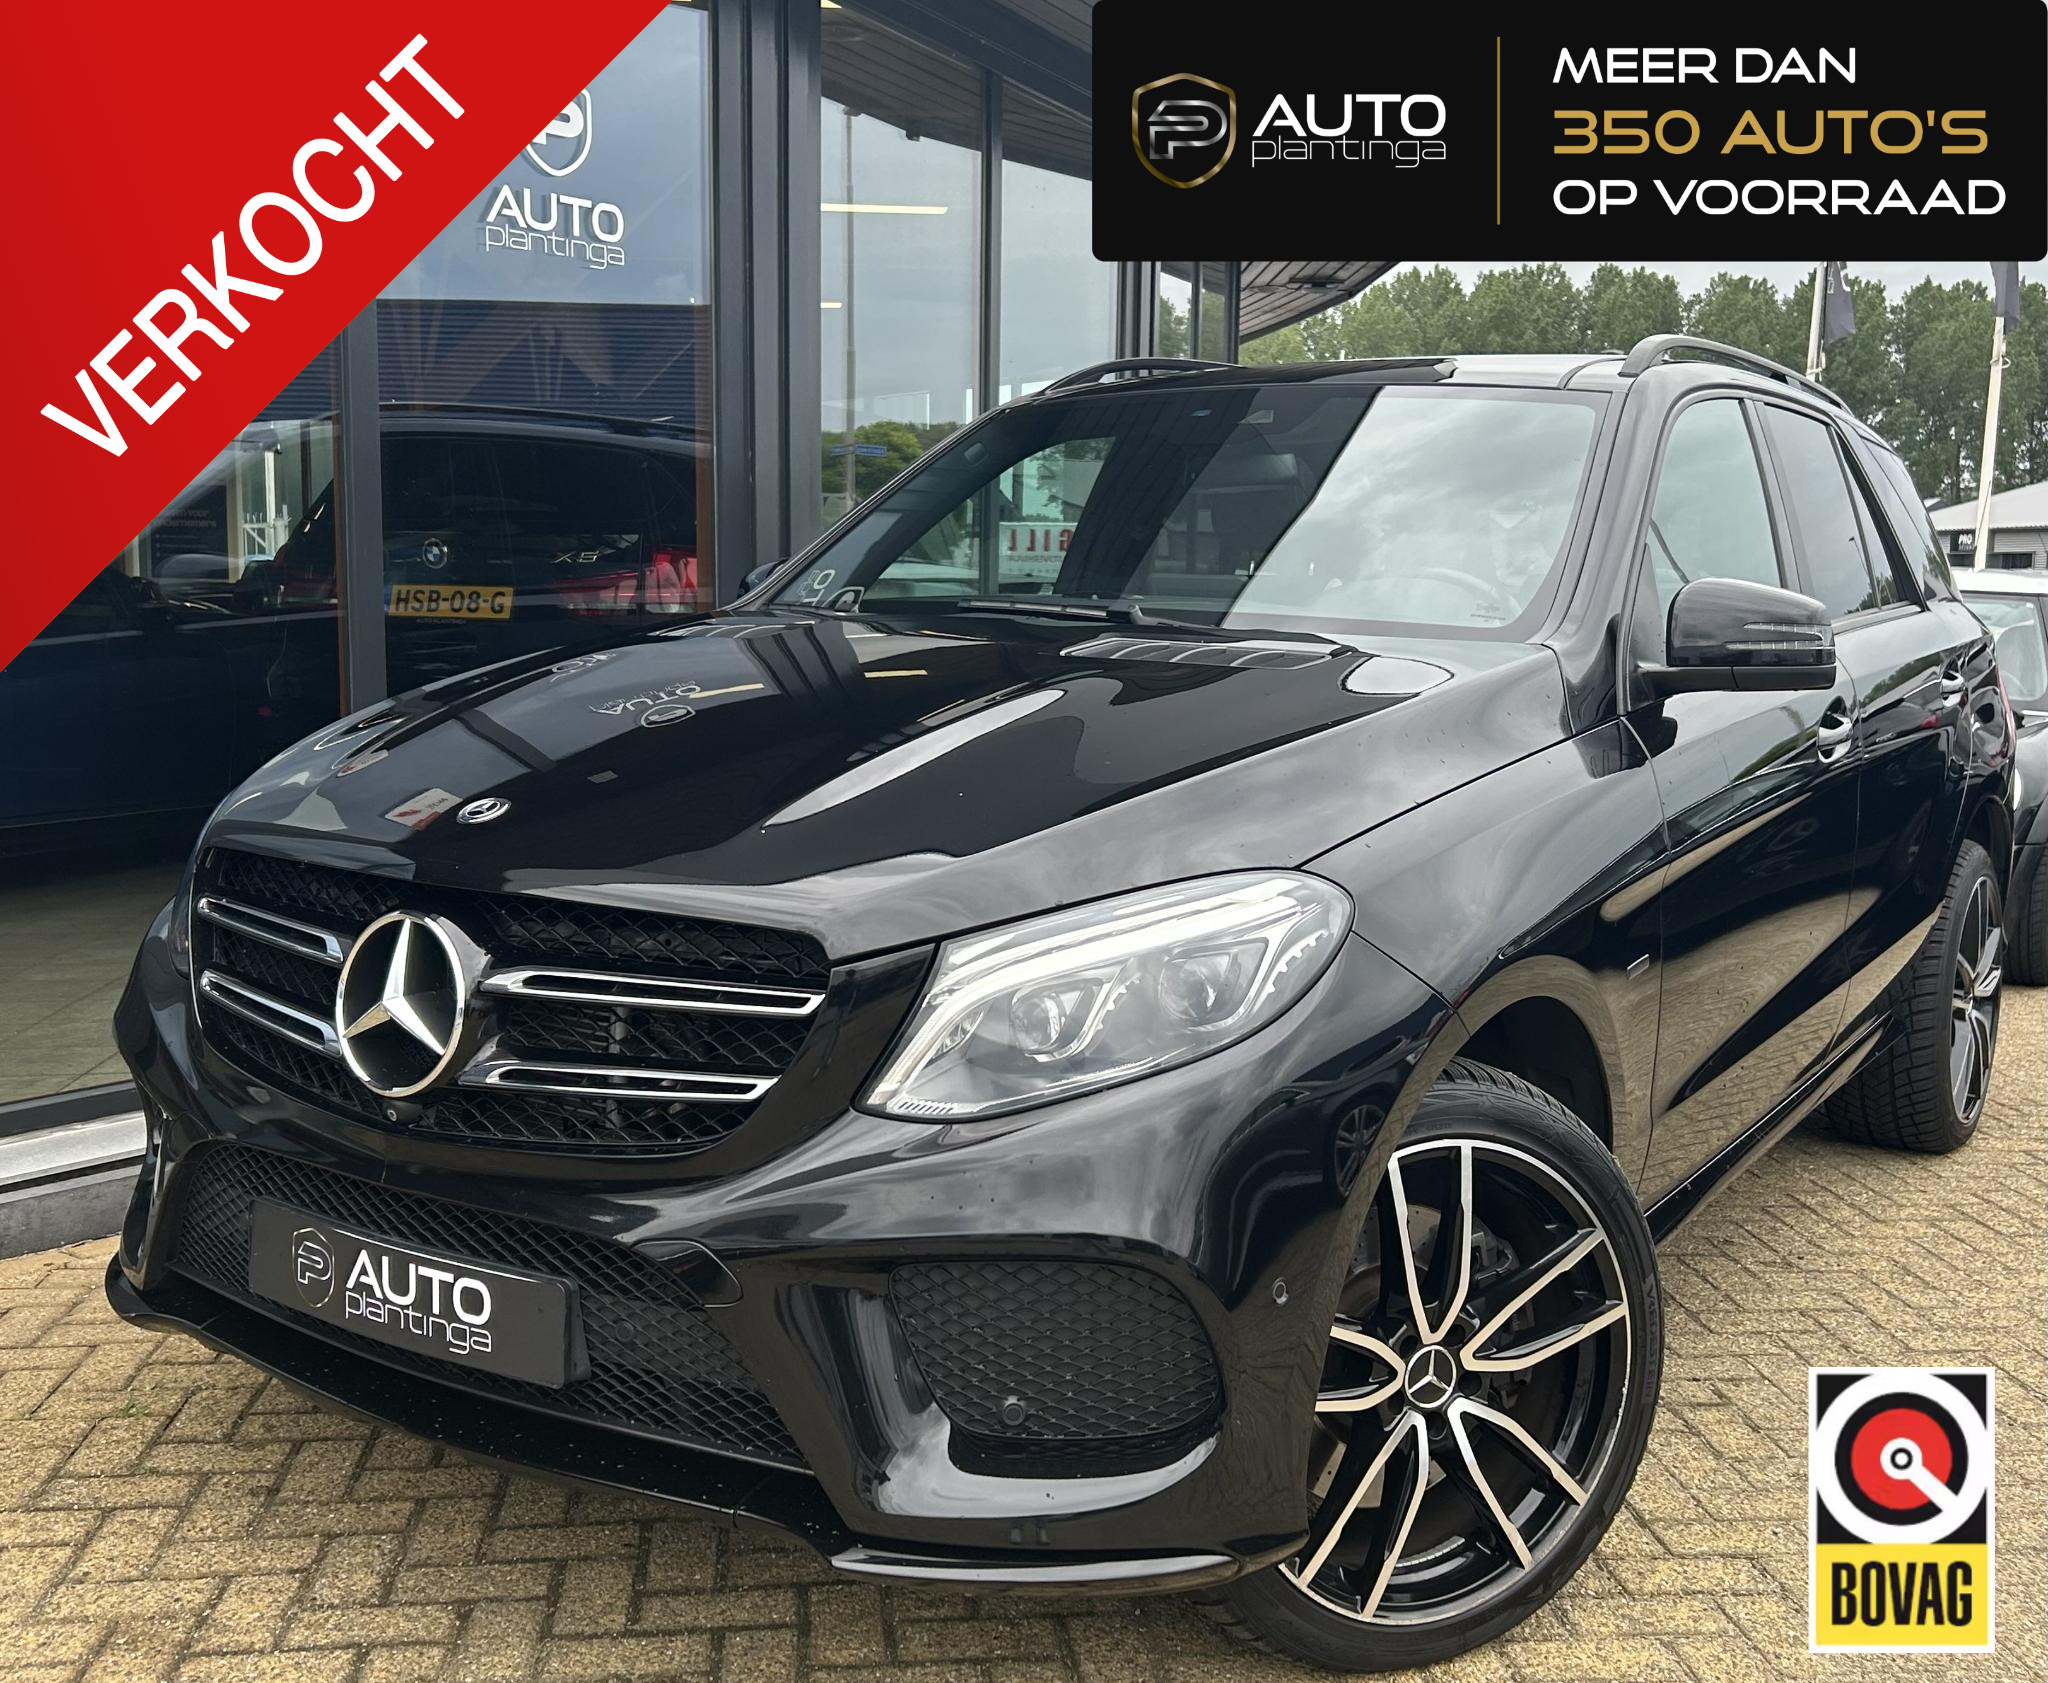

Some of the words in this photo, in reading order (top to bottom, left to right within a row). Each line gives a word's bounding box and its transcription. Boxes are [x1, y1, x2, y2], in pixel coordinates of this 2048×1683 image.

[486, 184, 625, 243] AUTO
[485, 224, 625, 270] plantinga
[1959, 533, 1973, 545] PRO
[394, 589, 507, 615] HSB-08-G
[345, 1249, 492, 1326] AUTO
[345, 1291, 492, 1355] plantinga
